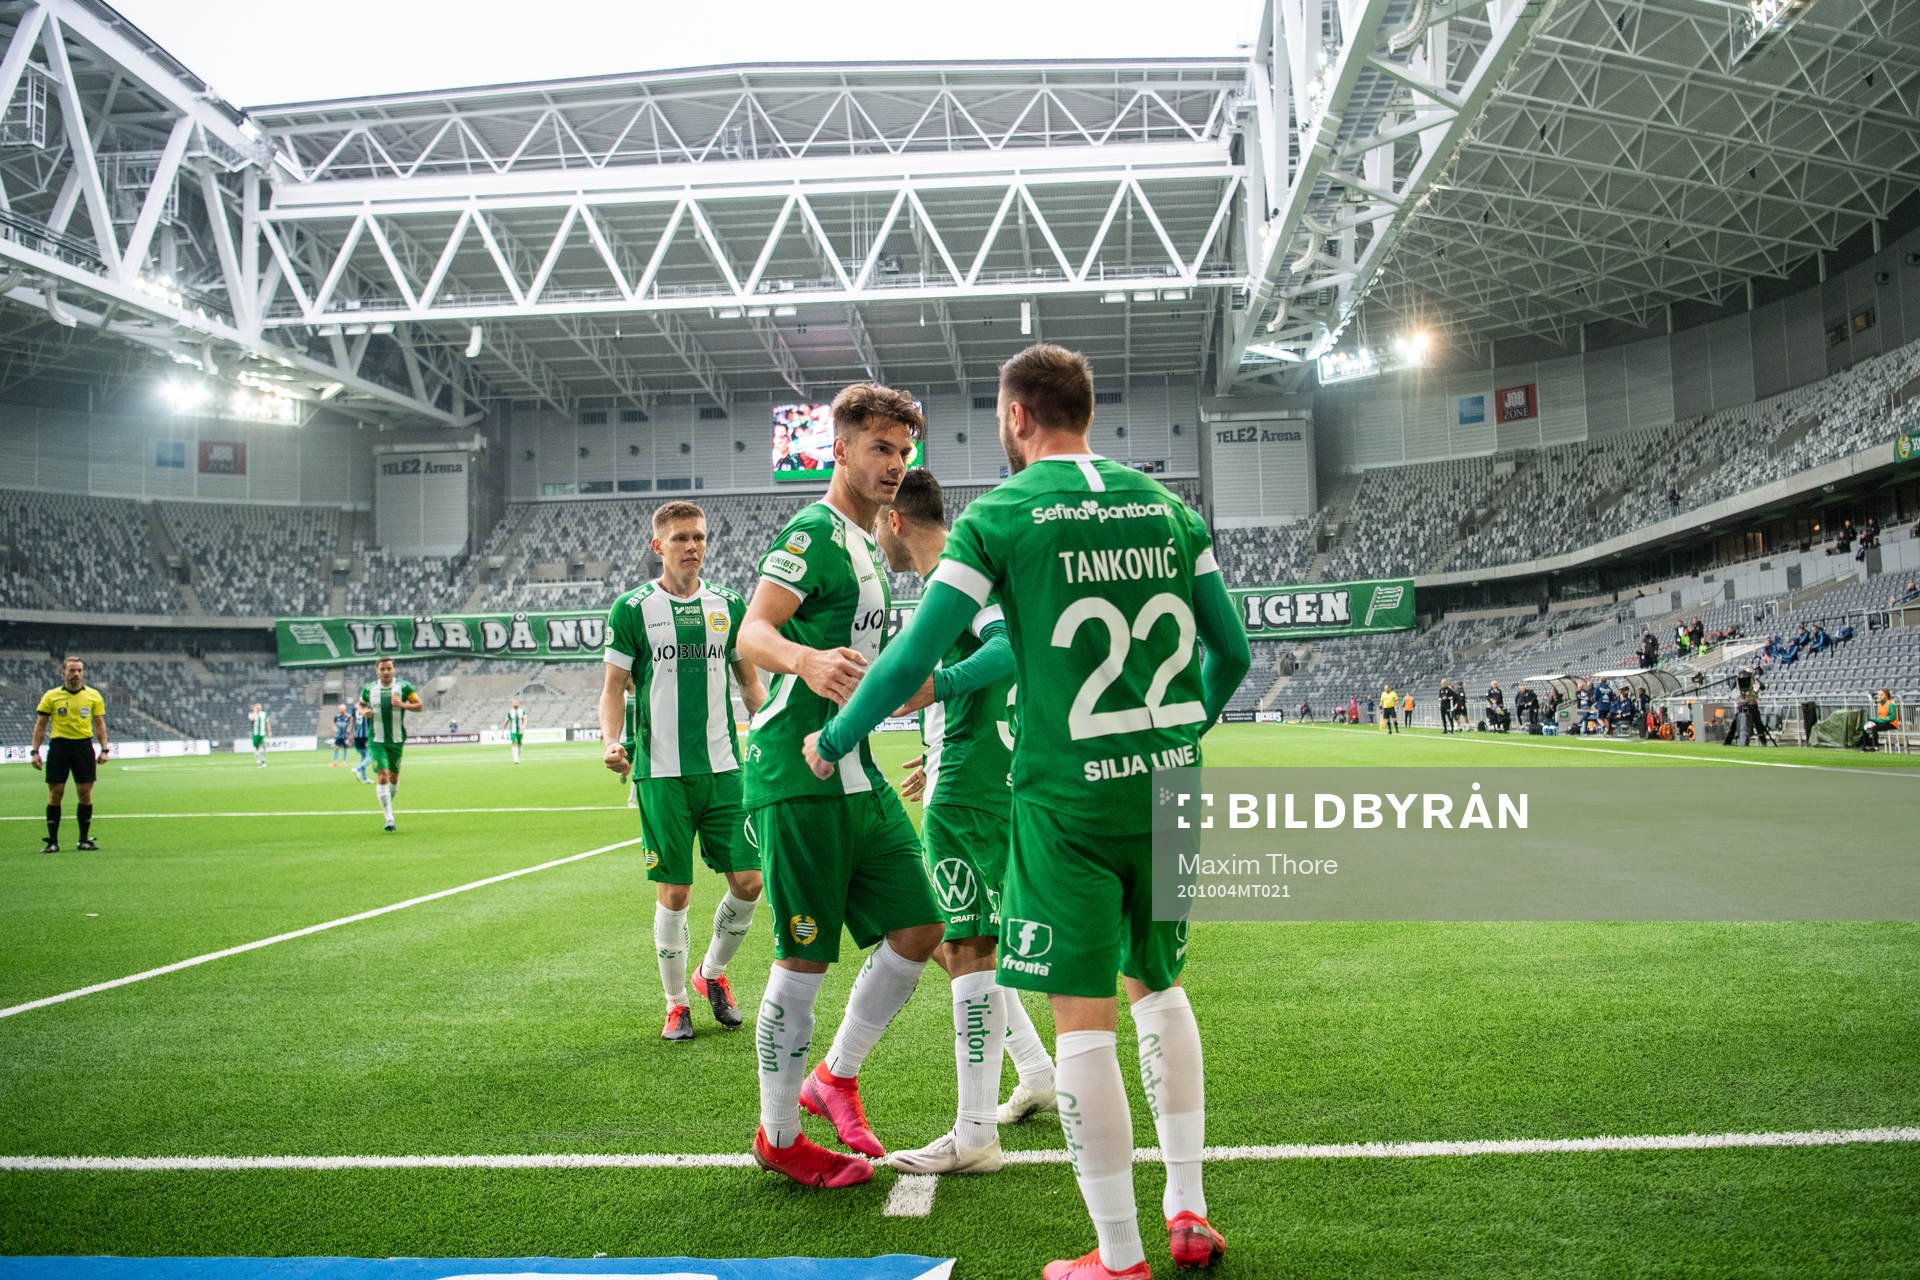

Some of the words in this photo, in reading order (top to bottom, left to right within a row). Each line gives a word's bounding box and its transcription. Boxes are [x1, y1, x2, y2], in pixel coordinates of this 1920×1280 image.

[1504, 390, 1525, 408] JOB
[1504, 406, 1529, 420] ZONE
[1216, 426, 1258, 443] TELE2
[1261, 430, 1302, 442] Arena
[382, 459, 421, 475] TELE2
[423, 461, 464, 474] Arena
[1031, 502, 1090, 524] Sefina
[1097, 502, 1174, 523] pantbank
[770, 555, 803, 573] UNIBET
[1058, 538, 1178, 584] TANKOVIĆ
[1245, 591, 1350, 627] IGEN
[348, 622, 398, 651] VI
[413, 615, 472, 651] ÄR
[482, 612, 537, 651] DÅ
[548, 619, 606, 651] NU
[654, 643, 725, 662] JOBMAN
[1051, 592, 1208, 741] 22
[1084, 754, 1148, 782] SILJA
[1150, 744, 1195, 772] LINE
[950, 913, 976, 924] CRAFT
[1001, 954, 1051, 977] fronta
[760, 999, 785, 1074] Clinton
